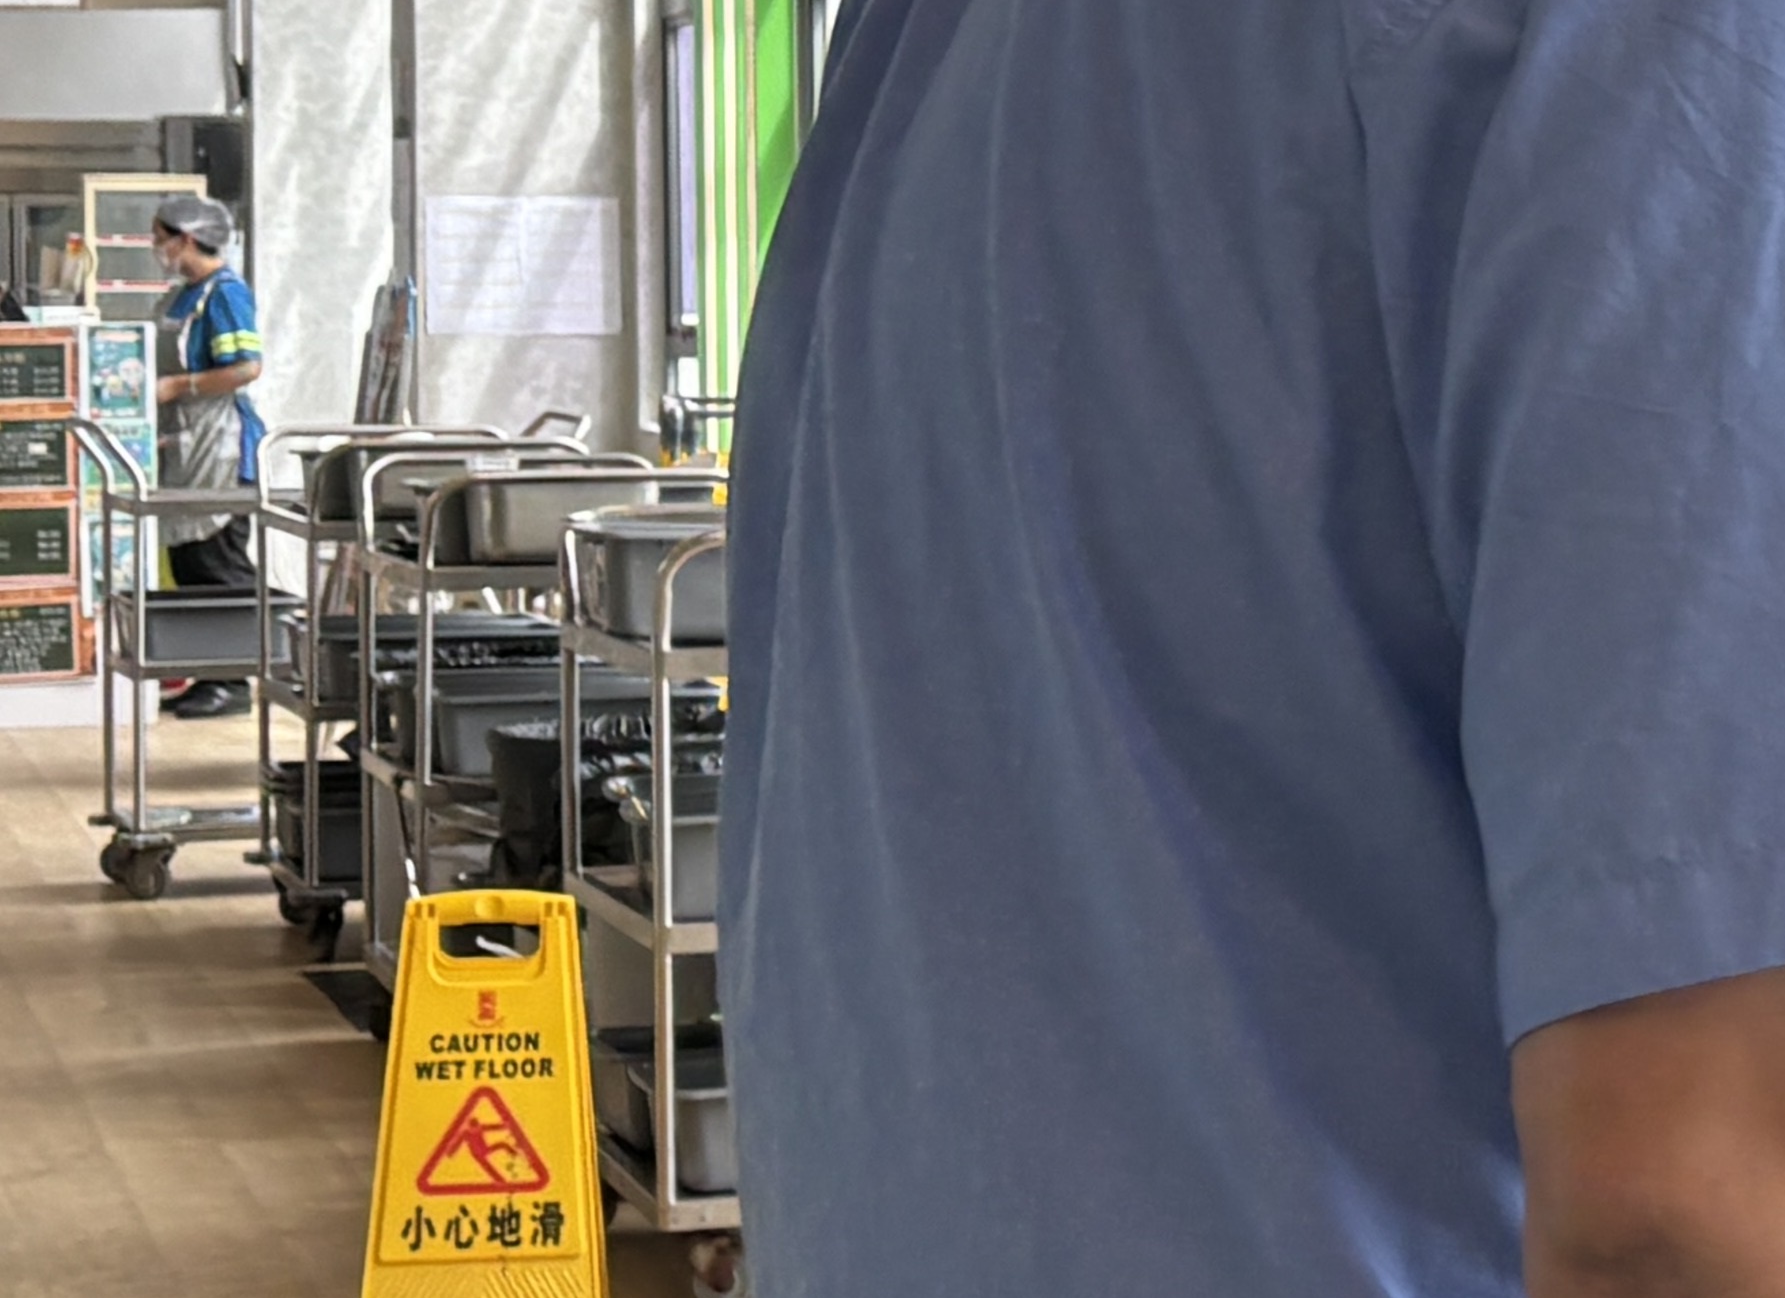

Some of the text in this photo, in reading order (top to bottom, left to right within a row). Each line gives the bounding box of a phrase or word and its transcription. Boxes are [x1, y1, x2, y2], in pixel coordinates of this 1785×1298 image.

[430, 1032, 540, 1054] CAUTION
[415, 1057, 554, 1080] WET FLOOR
[402, 1201, 566, 1251] 小心地滑
